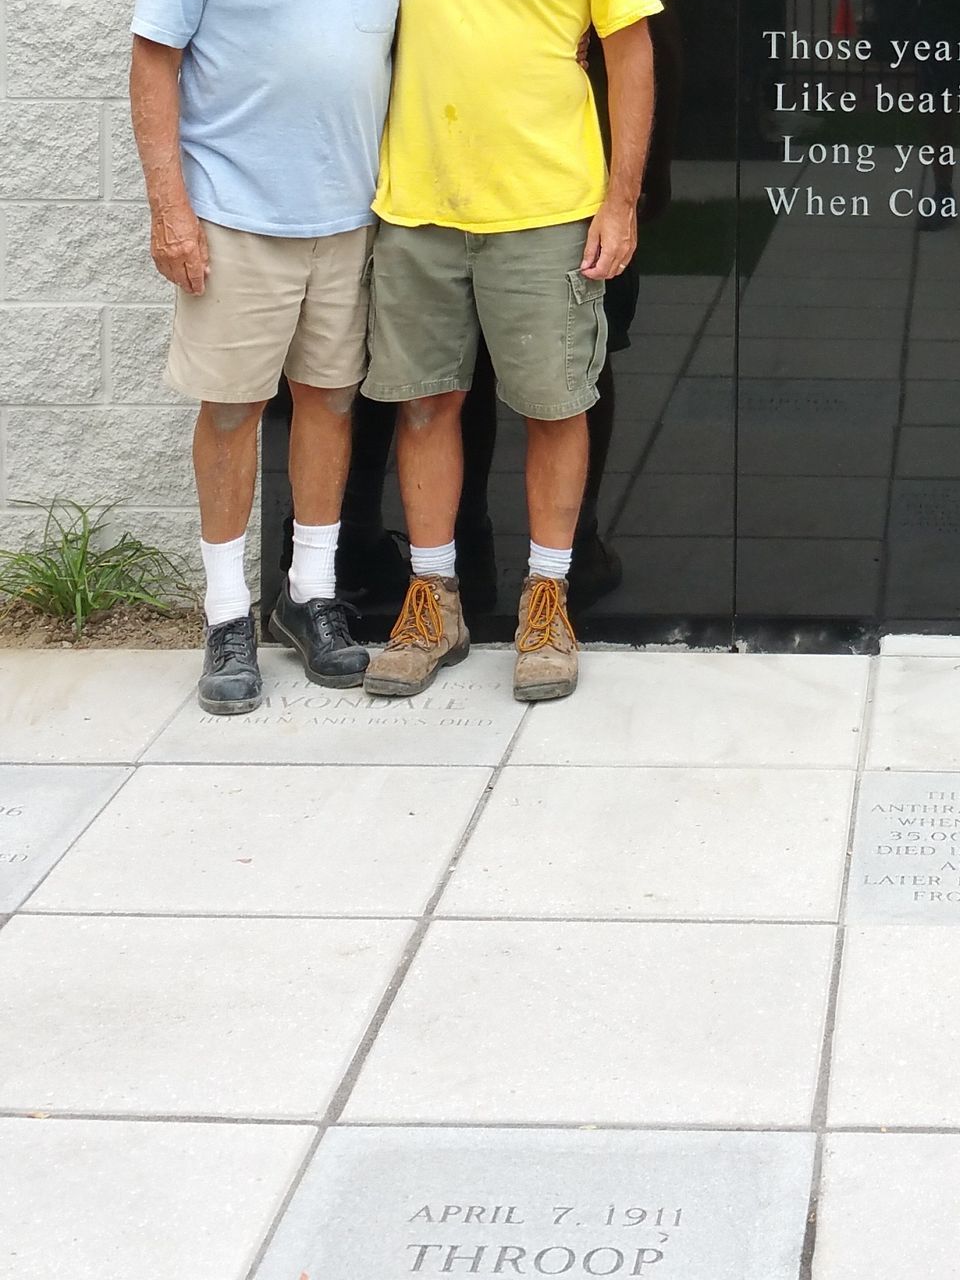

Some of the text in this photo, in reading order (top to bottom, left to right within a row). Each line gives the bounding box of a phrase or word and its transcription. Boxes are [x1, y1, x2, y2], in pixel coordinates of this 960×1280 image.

[762, 31, 872, 61] Those
[774, 83, 857, 113] Like
[782, 136, 875, 173] Long
[764, 187, 870, 216] When
[307, 717, 355, 725] AND
[368, 718, 427, 726] BOYS
[439, 718, 494, 726] DIED
[875, 845, 937, 856] DIED
[864, 874, 941, 886] LATER
[408, 1204, 525, 1225] APRIL
[603, 1204, 684, 1228] 1911
[405, 1243, 664, 1277] THROOP
